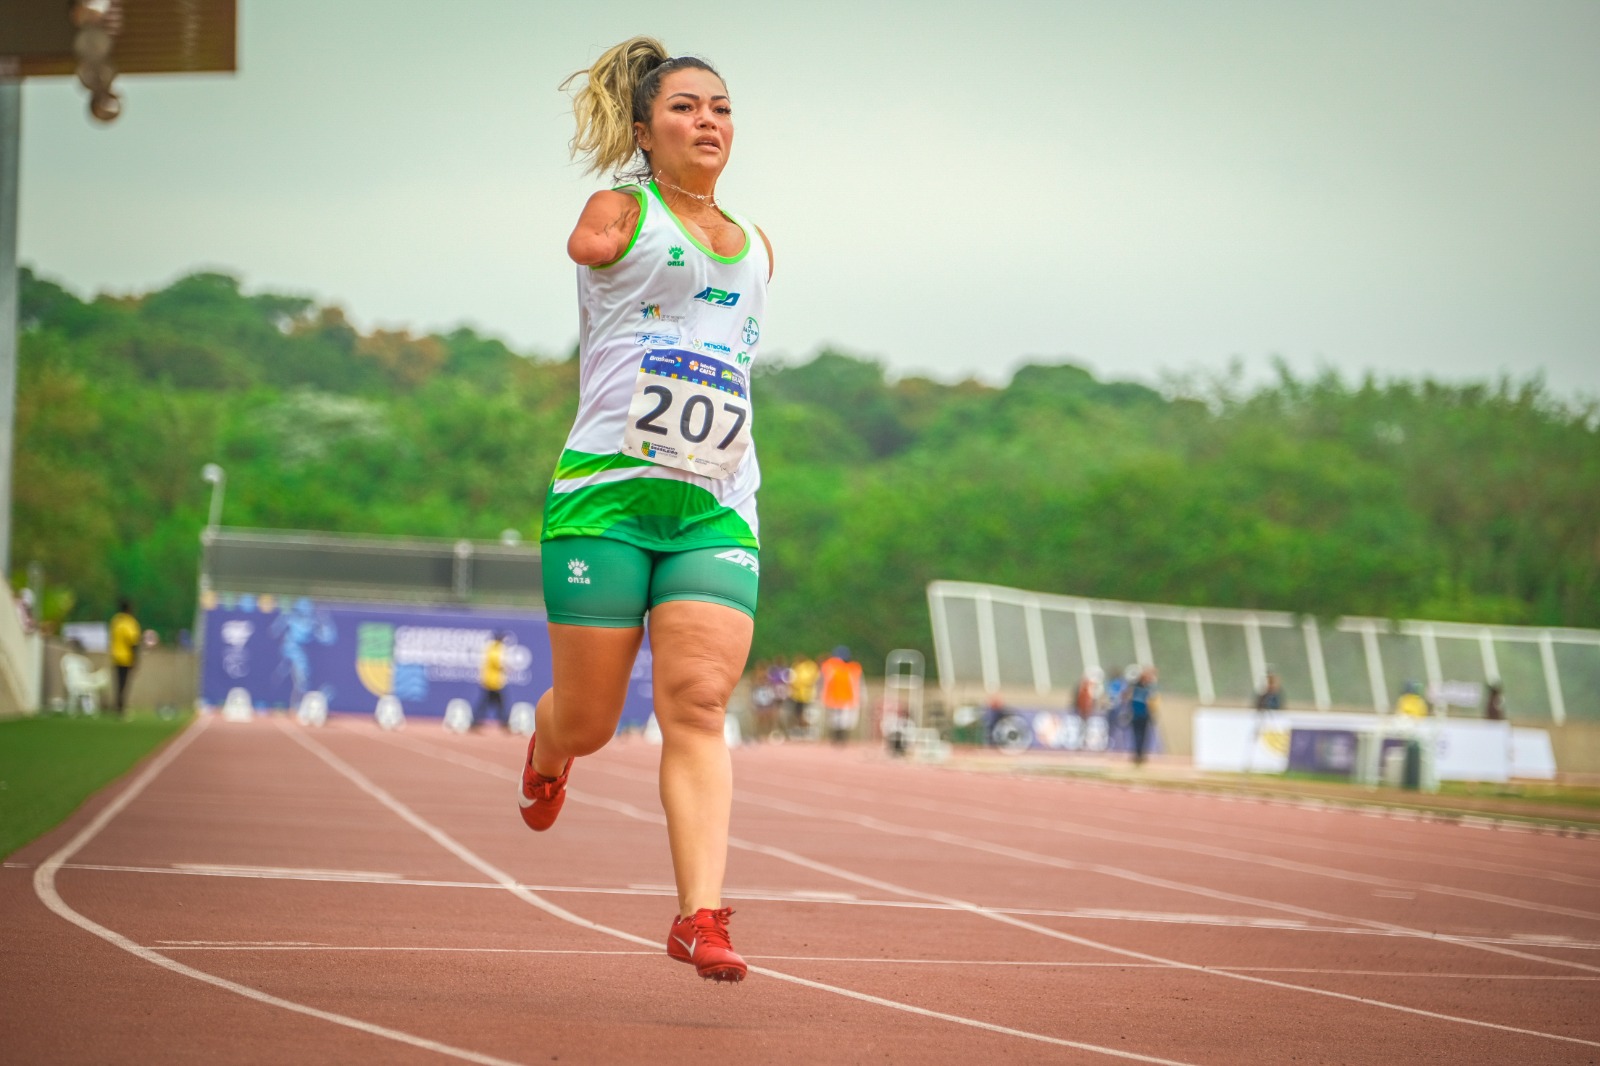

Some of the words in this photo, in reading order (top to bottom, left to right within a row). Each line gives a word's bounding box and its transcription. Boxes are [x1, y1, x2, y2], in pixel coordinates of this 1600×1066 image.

[649, 355, 675, 364] Braskem
[635, 384, 747, 451] 207
[567, 576, 591, 585] onza
